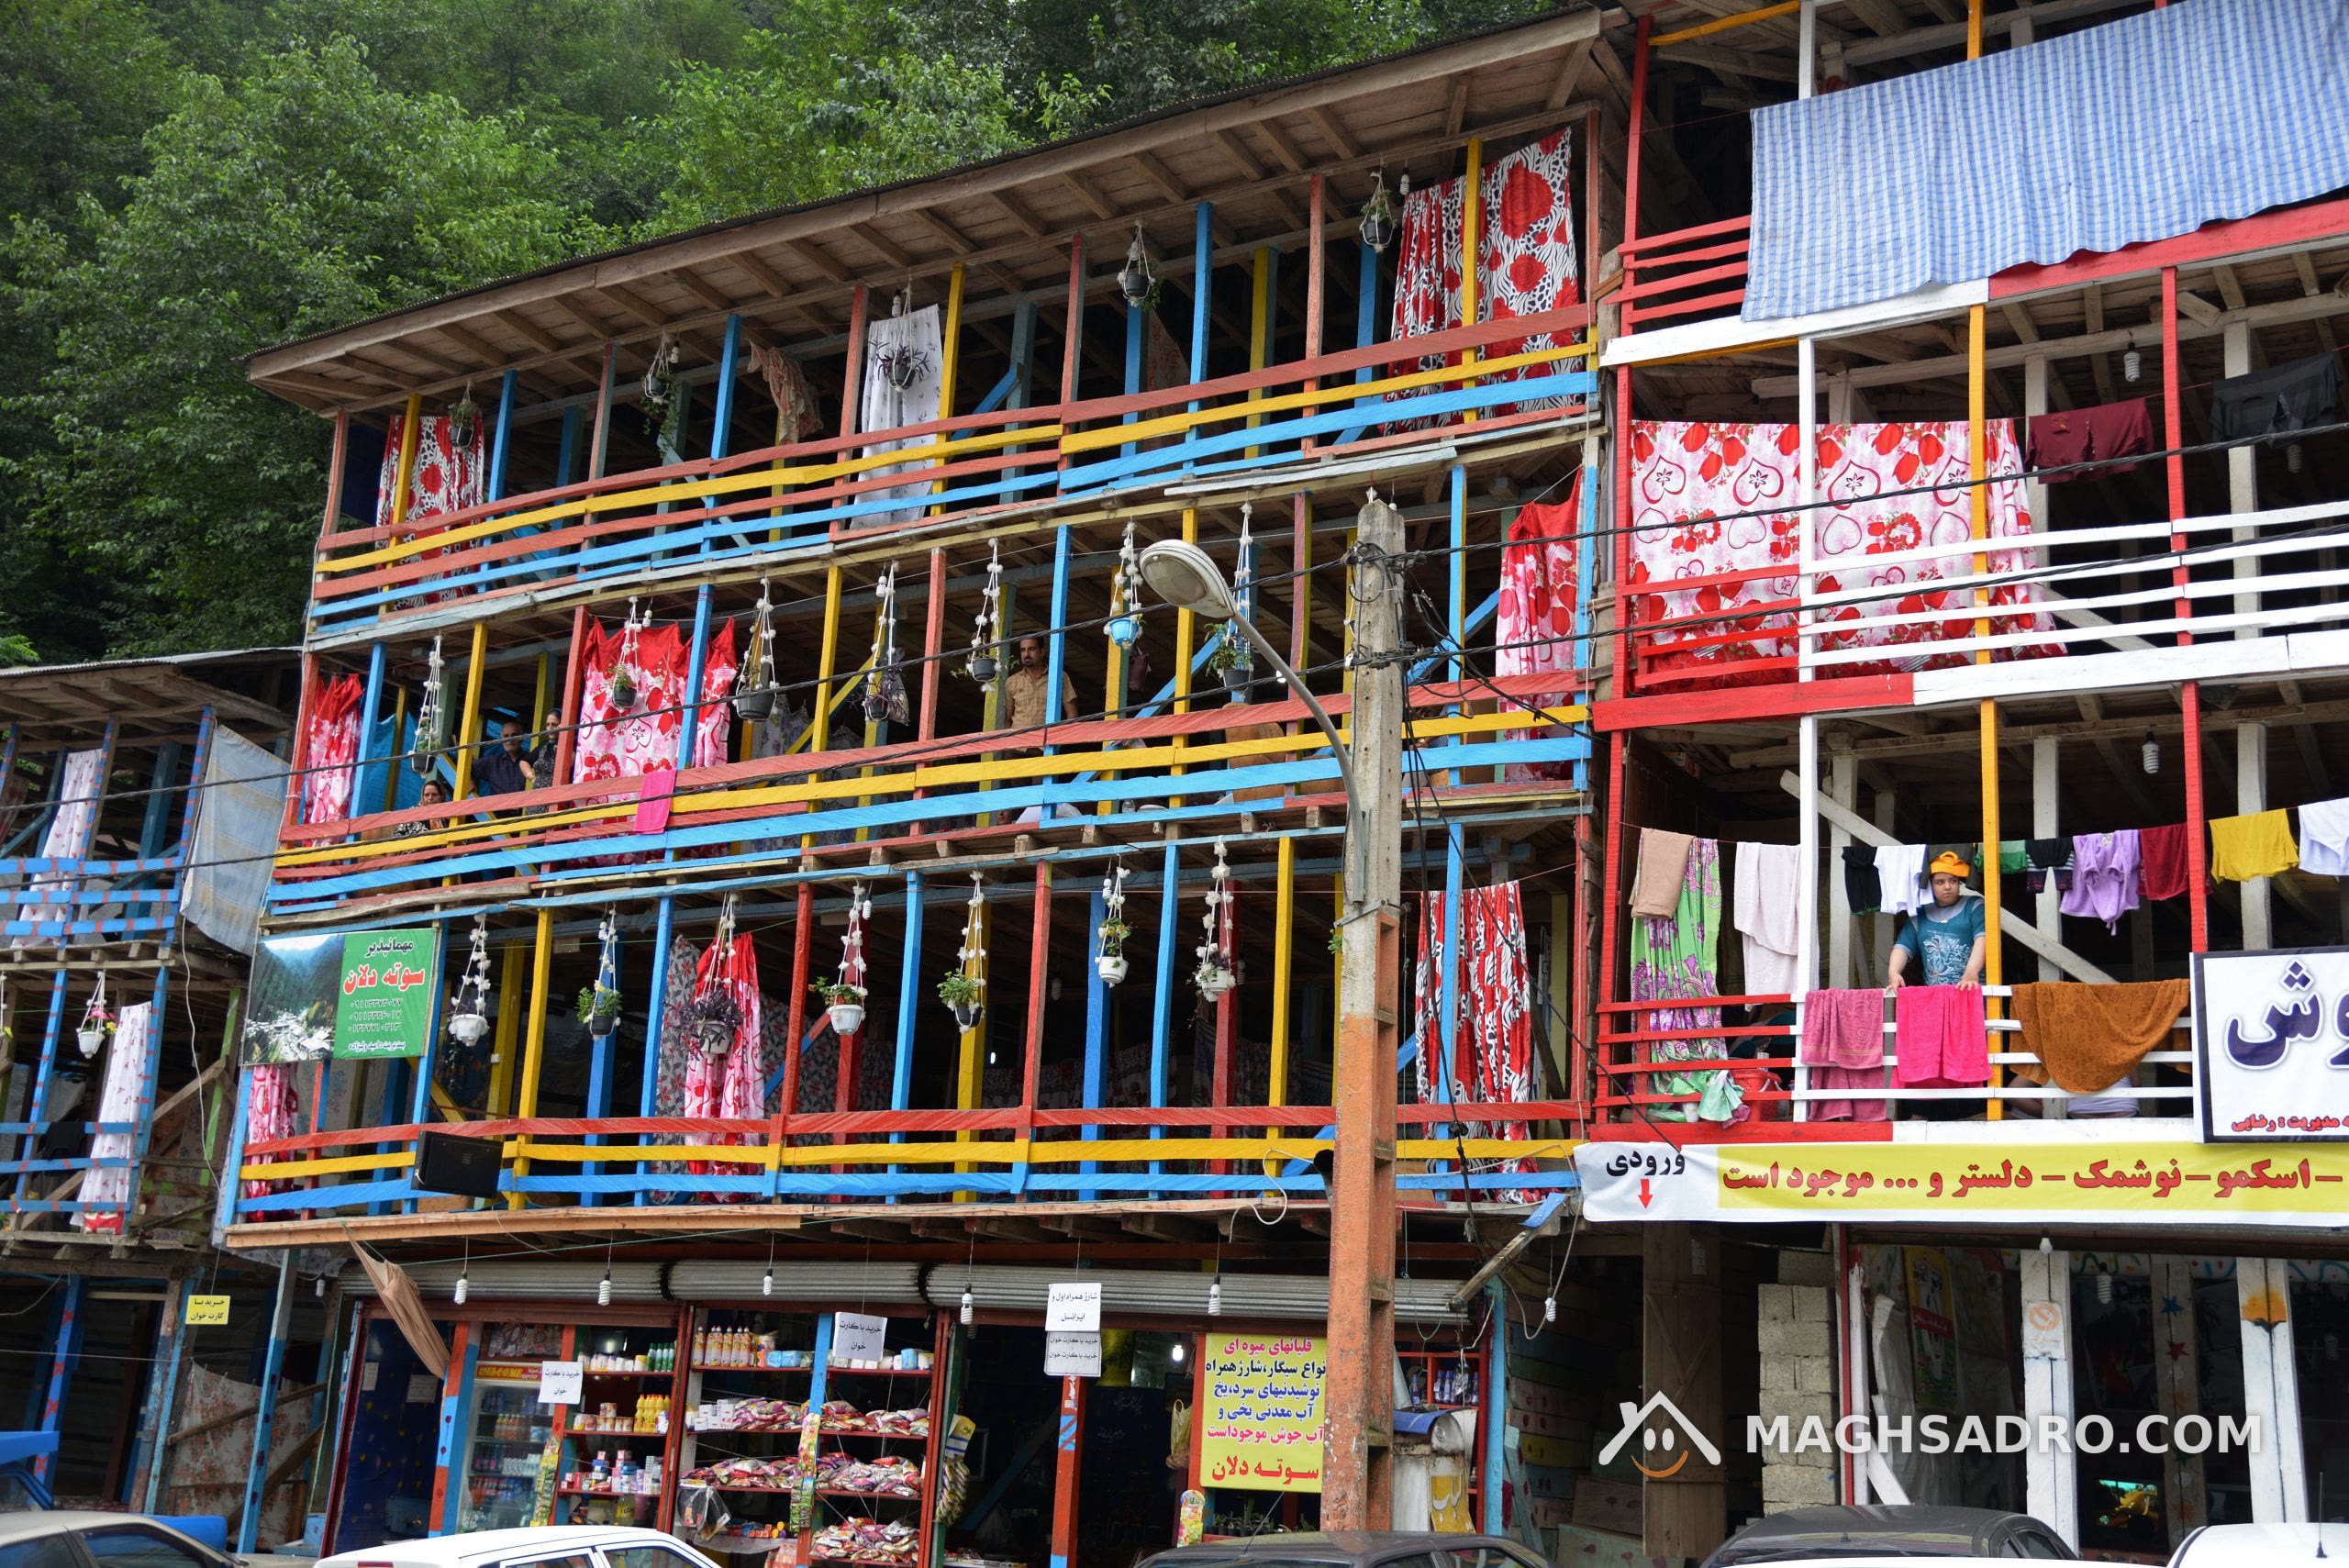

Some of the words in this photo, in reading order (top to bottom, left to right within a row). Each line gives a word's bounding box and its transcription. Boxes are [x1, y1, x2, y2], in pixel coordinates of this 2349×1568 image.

[365, 938, 413, 957] مهمانپذیر
[343, 964, 378, 994] دلان
[382, 963, 425, 991] سوته
[2232, 1114, 2277, 1132] رضایی
[2288, 1116, 2340, 1131] مدیریت
[1606, 1150, 1686, 1177] ورودی
[1722, 1161, 1780, 1189] است
[1787, 1166, 1875, 1197] موجود
[1952, 1158, 2032, 1198] دلستر
[2074, 1158, 2182, 1198] نوشمک
[2214, 1158, 2310, 1198] اسکمو
[1926, 1172, 1943, 1198] و
[840, 1321, 859, 1330] کارت
[865, 1326, 882, 1334] خرید
[851, 1342, 866, 1351] خوان
[1224, 1337, 1240, 1355] ای
[1241, 1341, 1265, 1355] میوه
[1268, 1337, 1312, 1356] قلیانهای
[1258, 1381, 1319, 1401] نوشیدنیهای
[1218, 1409, 1224, 1420] و
[1227, 1402, 1252, 1420] یخی
[1255, 1403, 1292, 1420] معدنی
[1296, 1403, 1314, 1422] آب
[1270, 1427, 1302, 1444] جوش
[1306, 1427, 1324, 1445] آب
[1212, 1455, 1249, 1481] دلان
[1253, 1458, 1319, 1485] سوته
